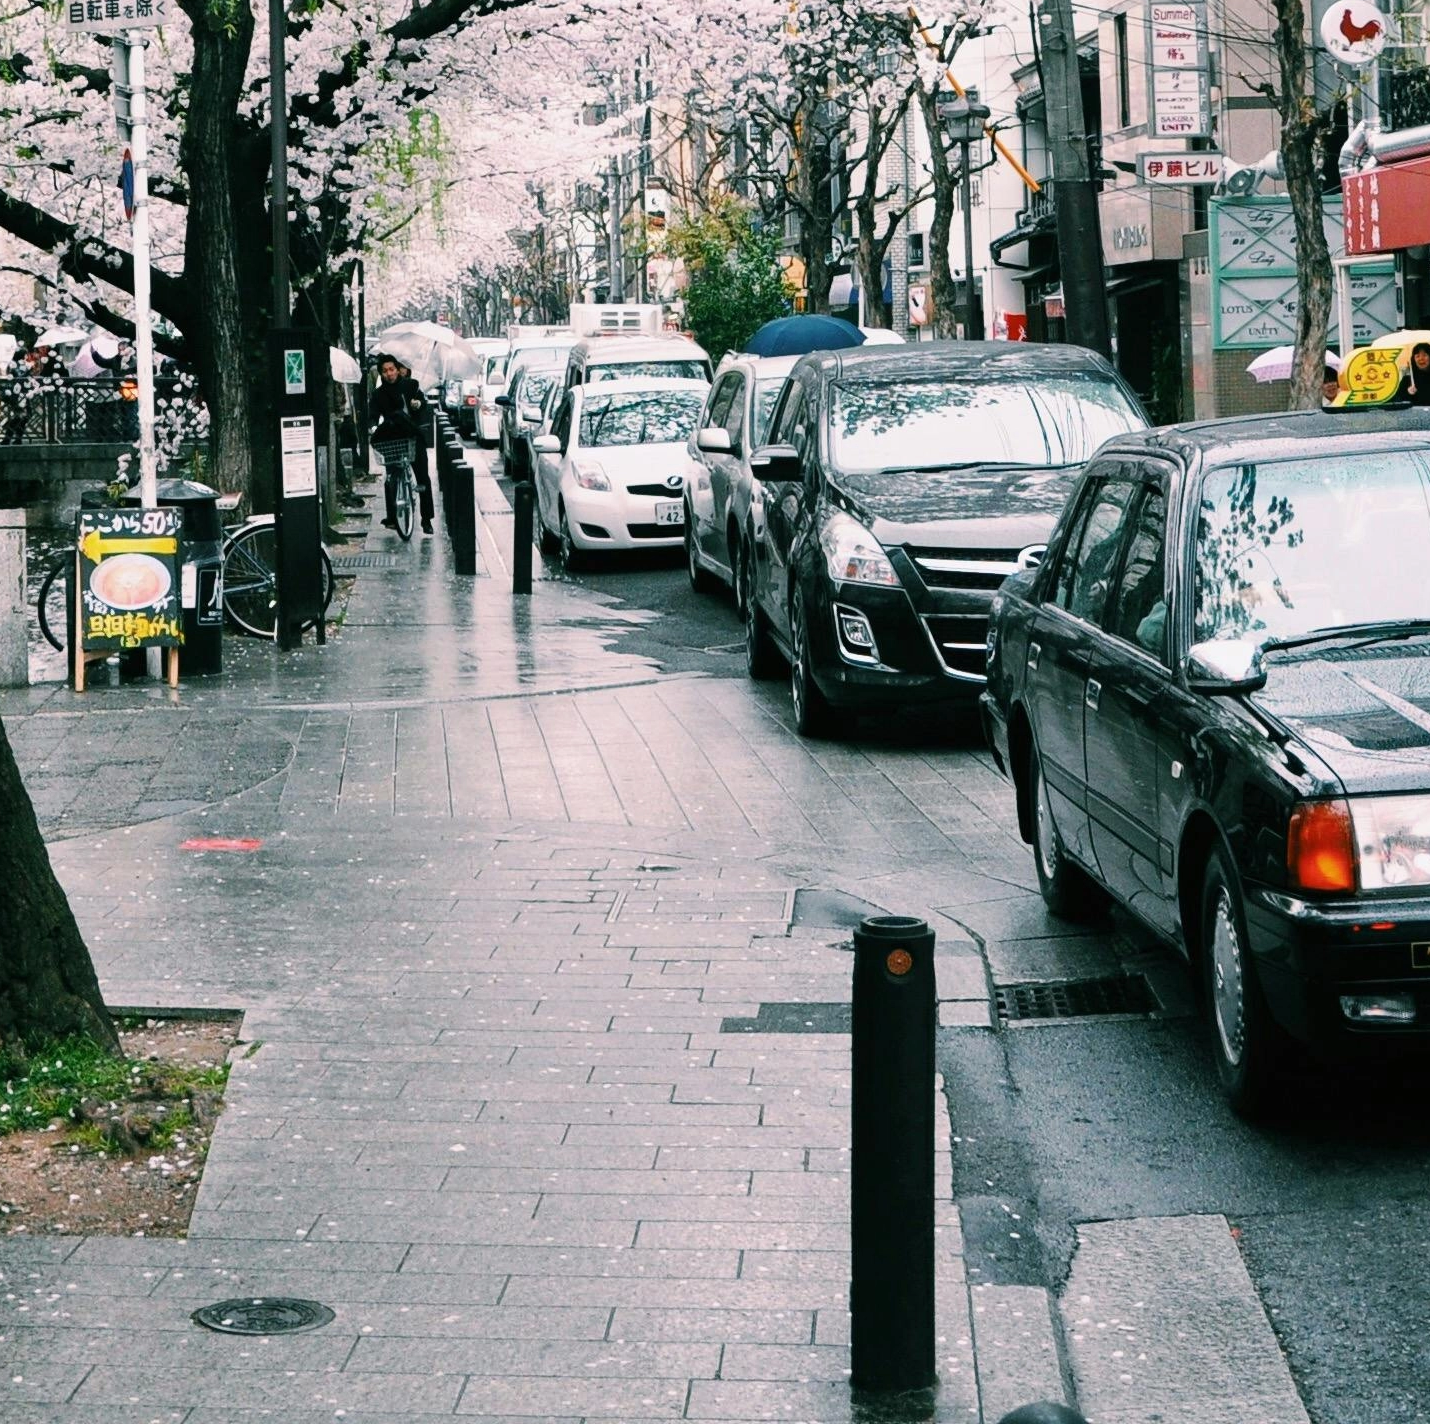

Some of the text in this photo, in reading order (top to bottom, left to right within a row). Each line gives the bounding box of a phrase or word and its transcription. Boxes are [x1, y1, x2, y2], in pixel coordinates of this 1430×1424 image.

[1161, 123, 1193, 132] UNITY
[1147, 160, 1219, 179] 伊藤ビル
[1221, 305, 1253, 315] LOTUS
